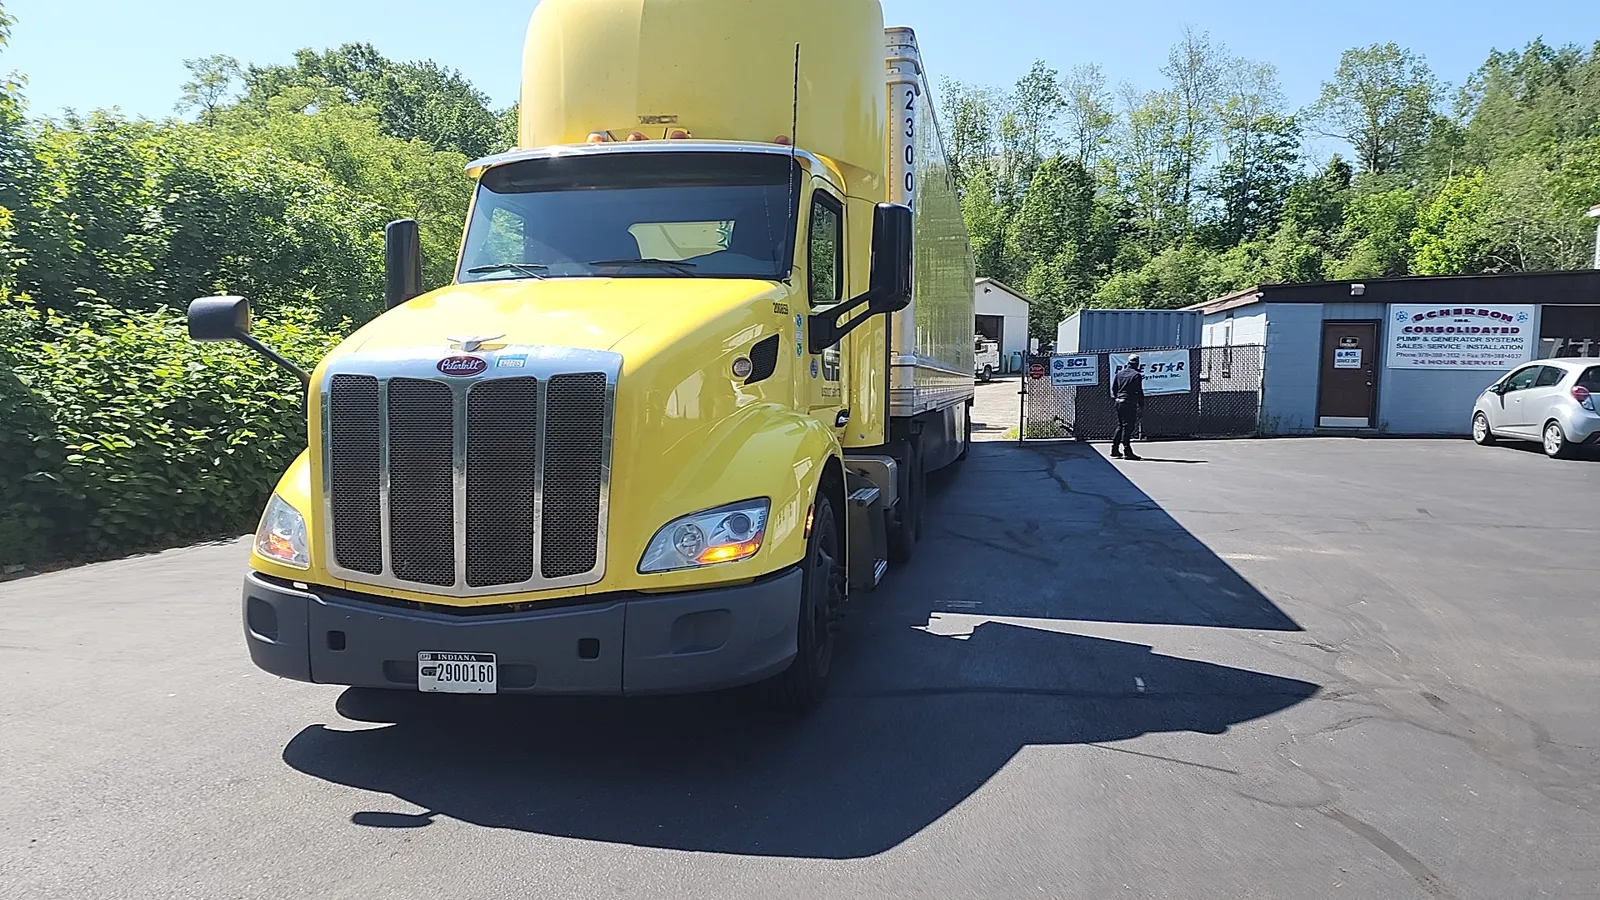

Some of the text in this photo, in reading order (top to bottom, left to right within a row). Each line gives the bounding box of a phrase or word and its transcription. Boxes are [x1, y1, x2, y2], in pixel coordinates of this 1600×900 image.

[1412, 308, 1514, 324] SCHERBON
[1402, 326, 1520, 335] CONSOLIDATED
[441, 359, 482, 371] Peterbilt
[1067, 358, 1088, 367] SCI
[438, 653, 477, 661] INDIANA
[437, 663, 494, 683] 2900160
